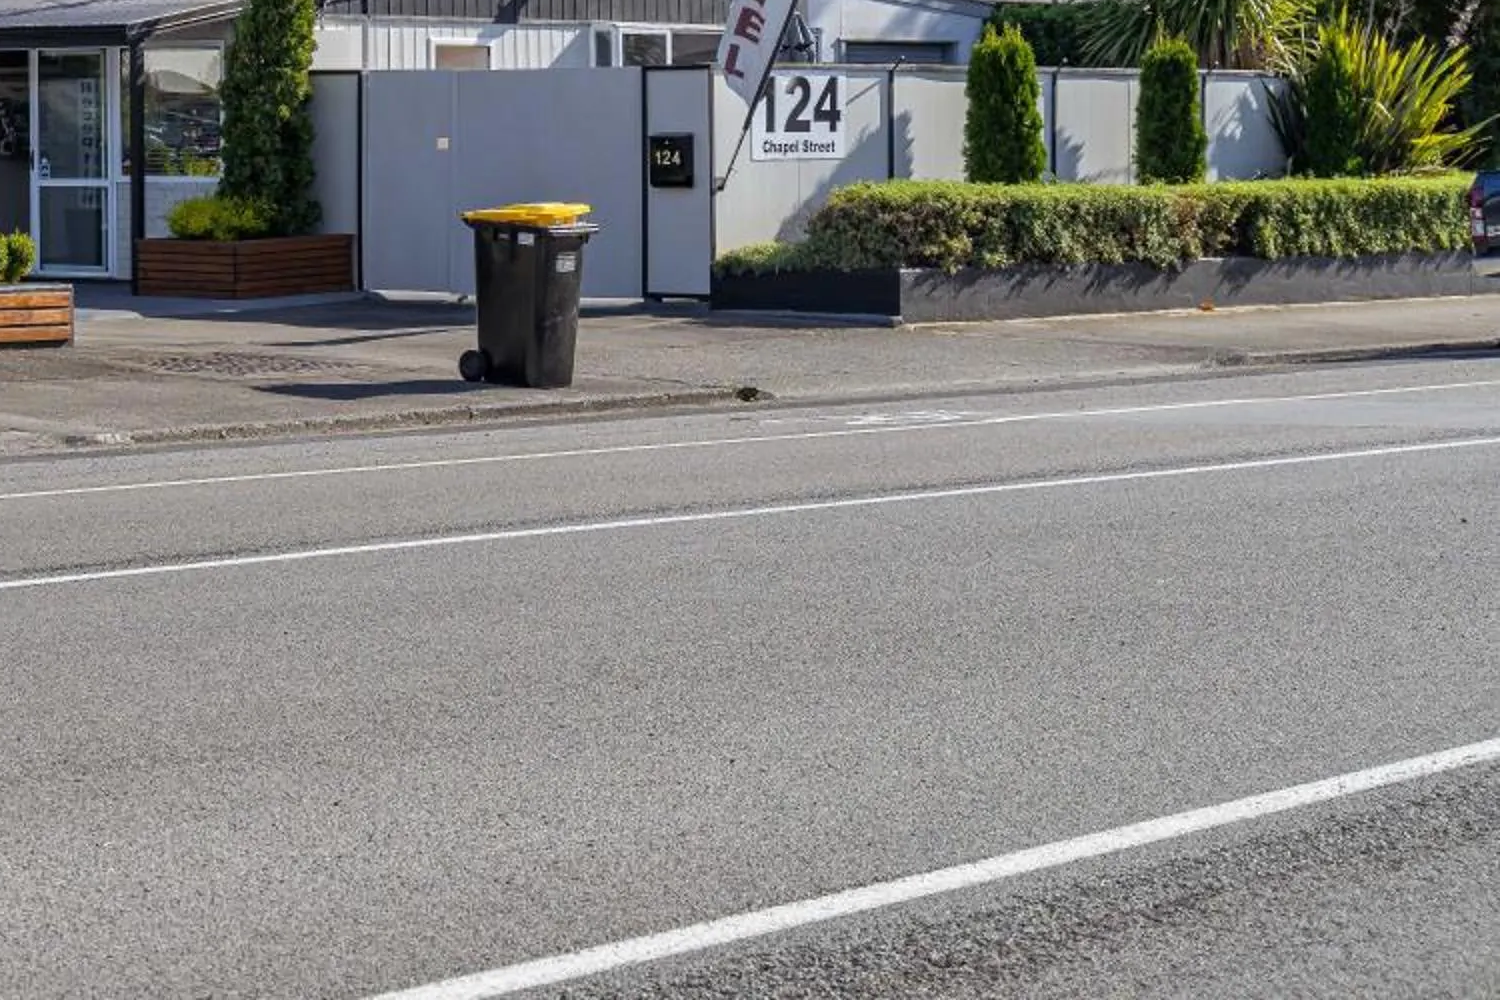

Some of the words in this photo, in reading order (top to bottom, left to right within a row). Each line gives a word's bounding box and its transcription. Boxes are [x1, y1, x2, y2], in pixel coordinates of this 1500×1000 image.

[761, 76, 841, 132] 124
[763, 140, 799, 155] Chapel
[802, 140, 835, 153] Street
[655, 150, 681, 165] 124
